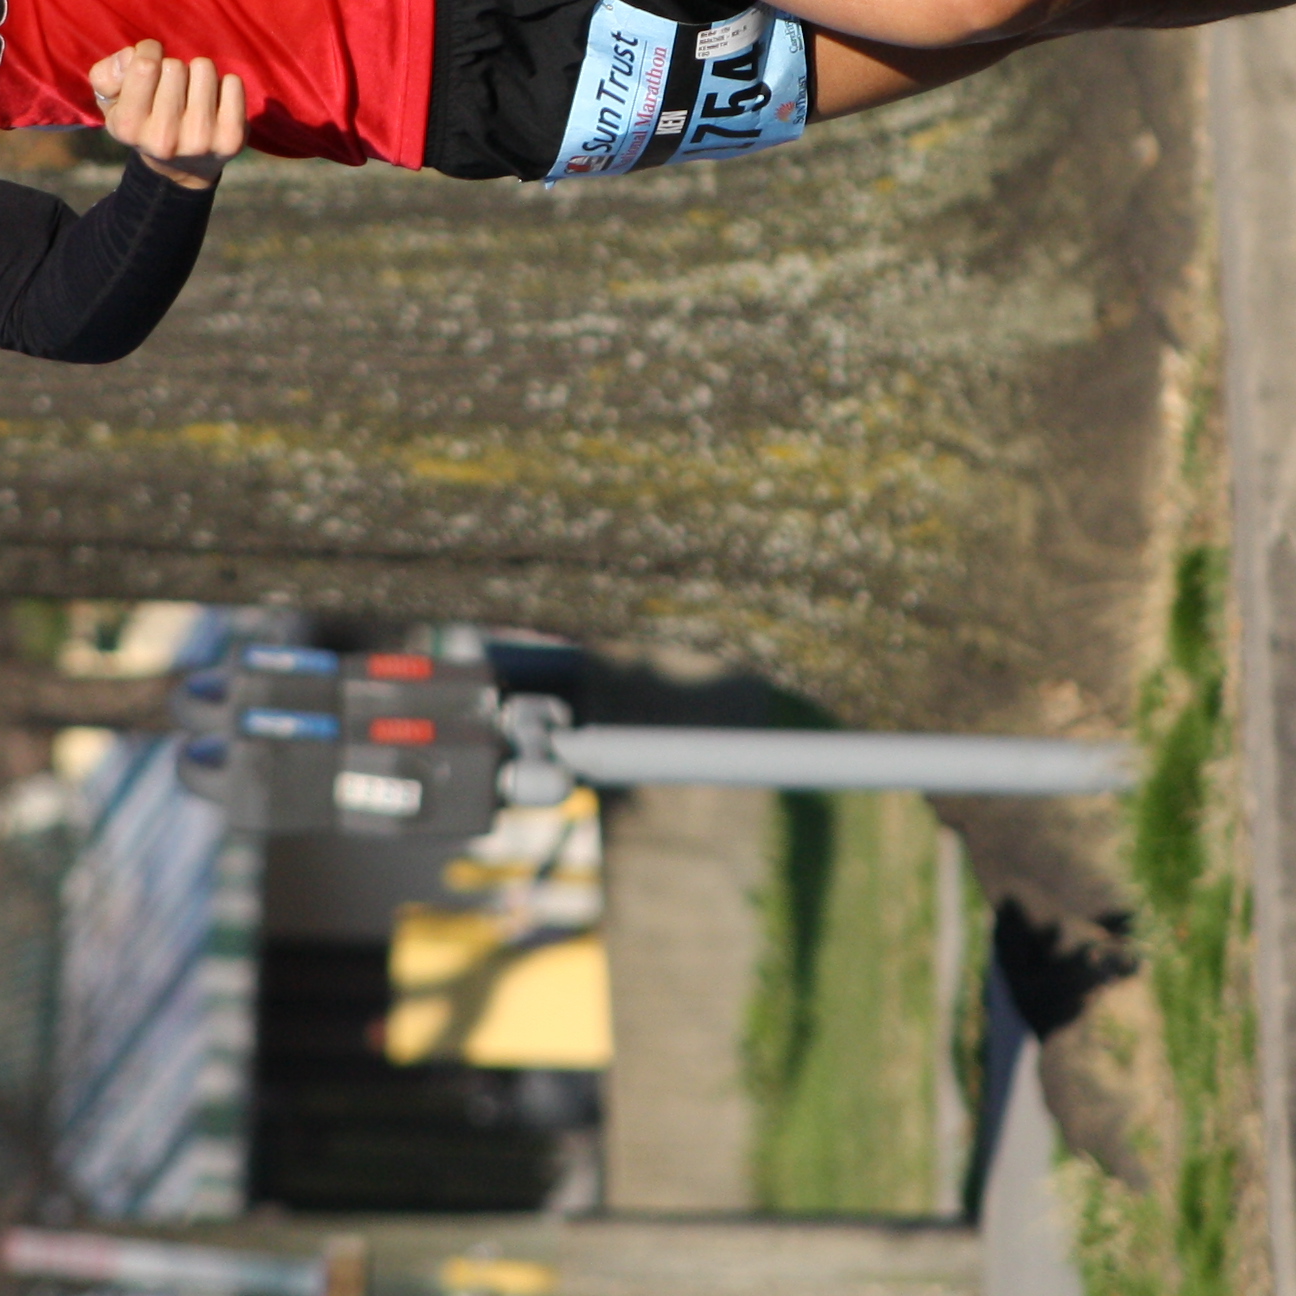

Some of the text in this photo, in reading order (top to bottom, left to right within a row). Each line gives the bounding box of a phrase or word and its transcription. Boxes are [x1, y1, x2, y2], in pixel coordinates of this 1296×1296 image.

[614, 46, 668, 170] National Marathon
[656, 109, 688, 135] KEN
[682, 44, 772, 155] 1754
